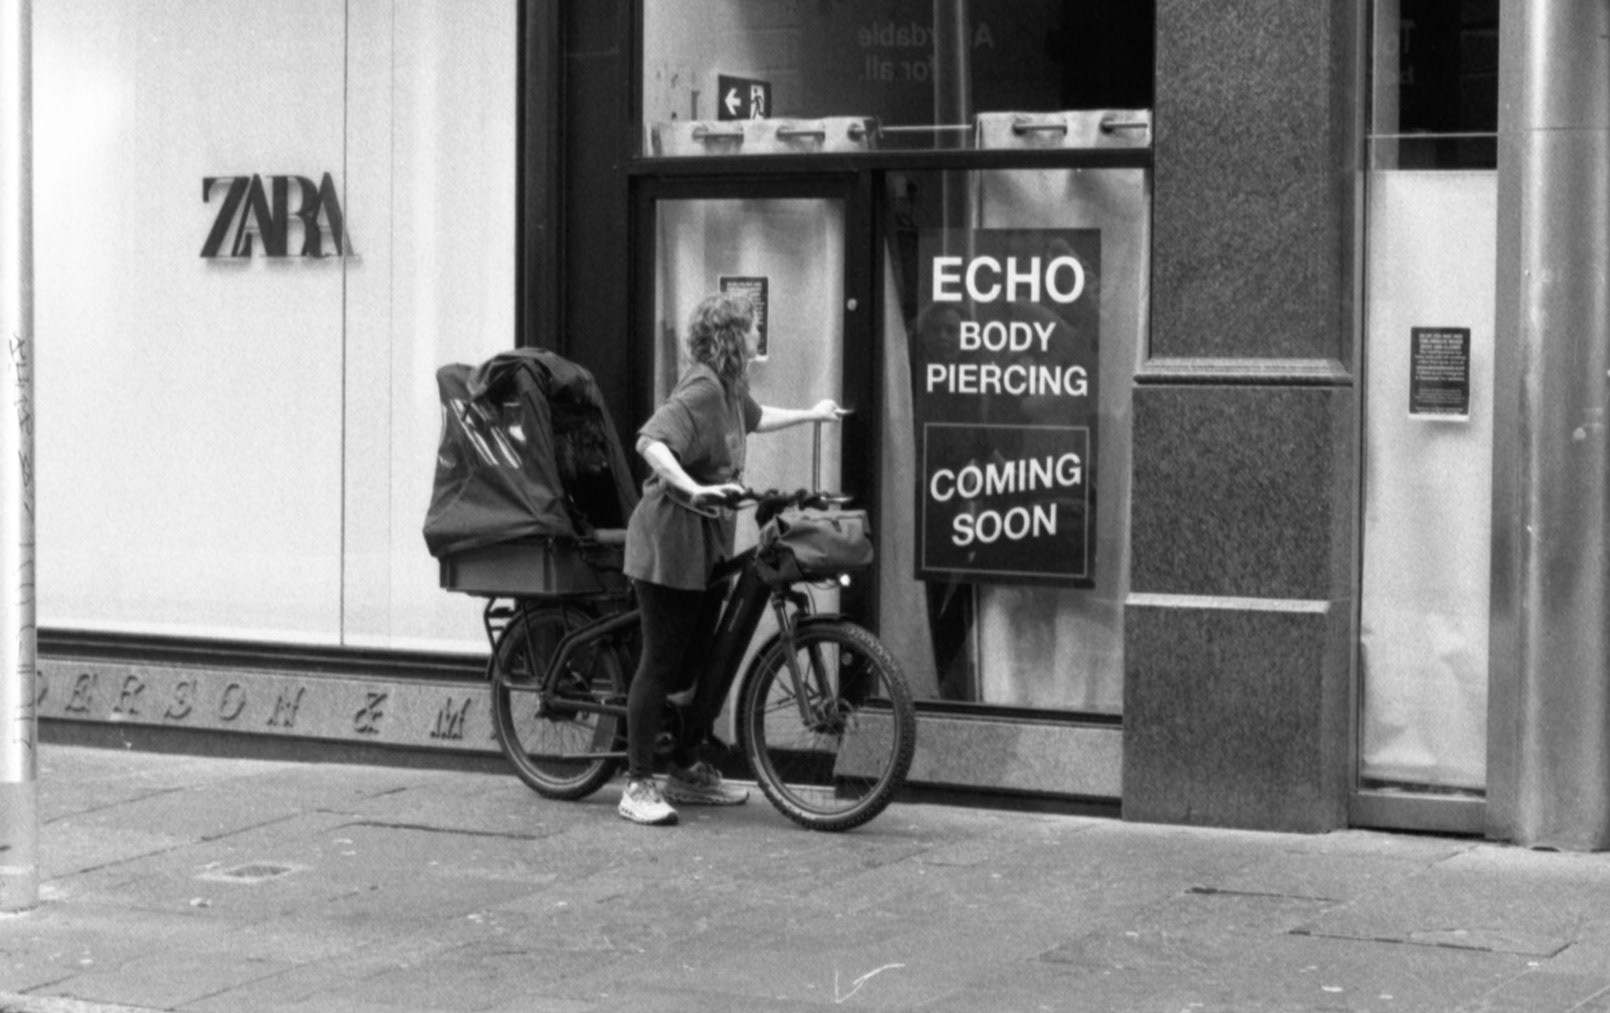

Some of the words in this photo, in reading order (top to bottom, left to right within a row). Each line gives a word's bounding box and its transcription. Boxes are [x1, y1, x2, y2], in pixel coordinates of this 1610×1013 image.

[200, 171, 353, 259] ZARA
[932, 256, 1085, 303] ECHO
[960, 321, 1057, 352] BODY
[926, 363, 1088, 396] PIERCING
[930, 453, 1082, 502] COMING
[952, 503, 1058, 546] SOON
